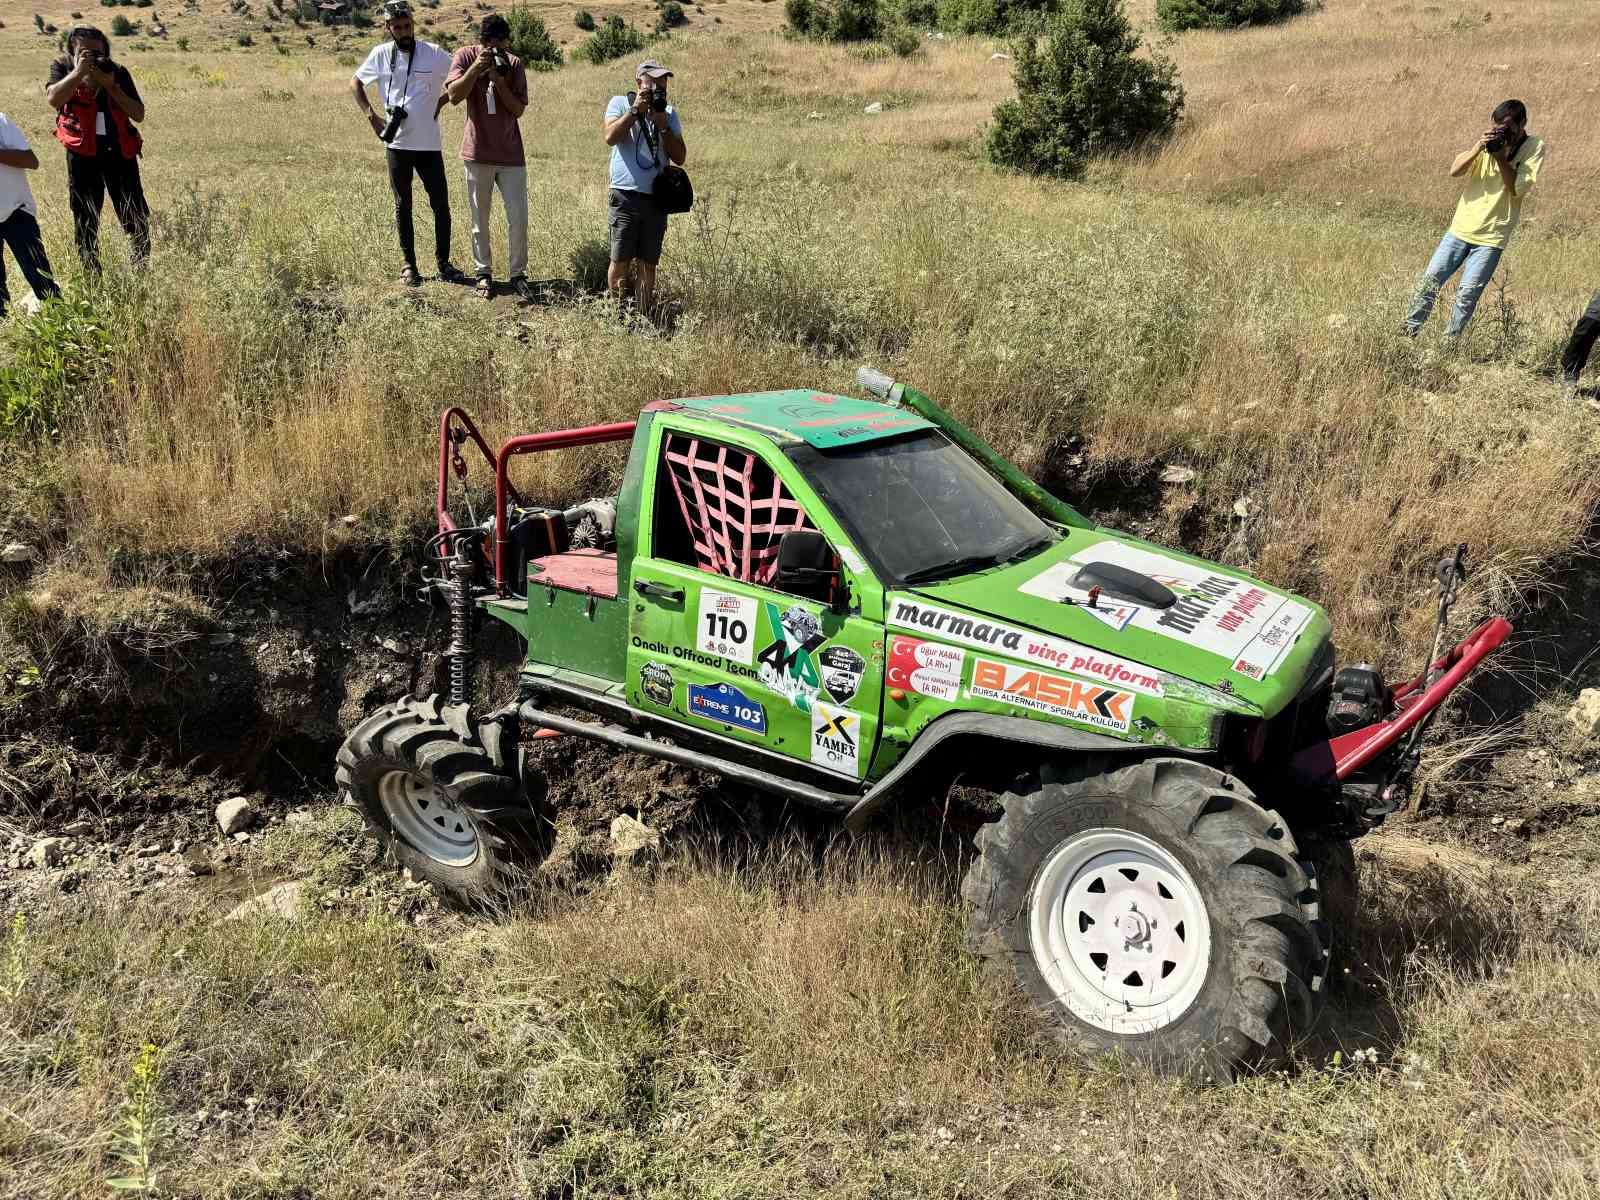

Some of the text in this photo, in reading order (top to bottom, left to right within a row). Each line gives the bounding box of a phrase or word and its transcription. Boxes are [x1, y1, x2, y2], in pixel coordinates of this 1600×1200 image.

[706, 613, 748, 644] 110
[673, 646, 721, 668] Offroad
[726, 658, 758, 680] Team
[895, 602, 1160, 692] marmara vinç platform
[693, 694, 730, 711] EXTREME
[734, 705, 761, 723] 103
[972, 686, 999, 699] BURSA
[1050, 705, 1088, 721] SPORLAR
[1090, 715, 1127, 731] KULÜBÜ
[815, 733, 856, 759] YAMEX
